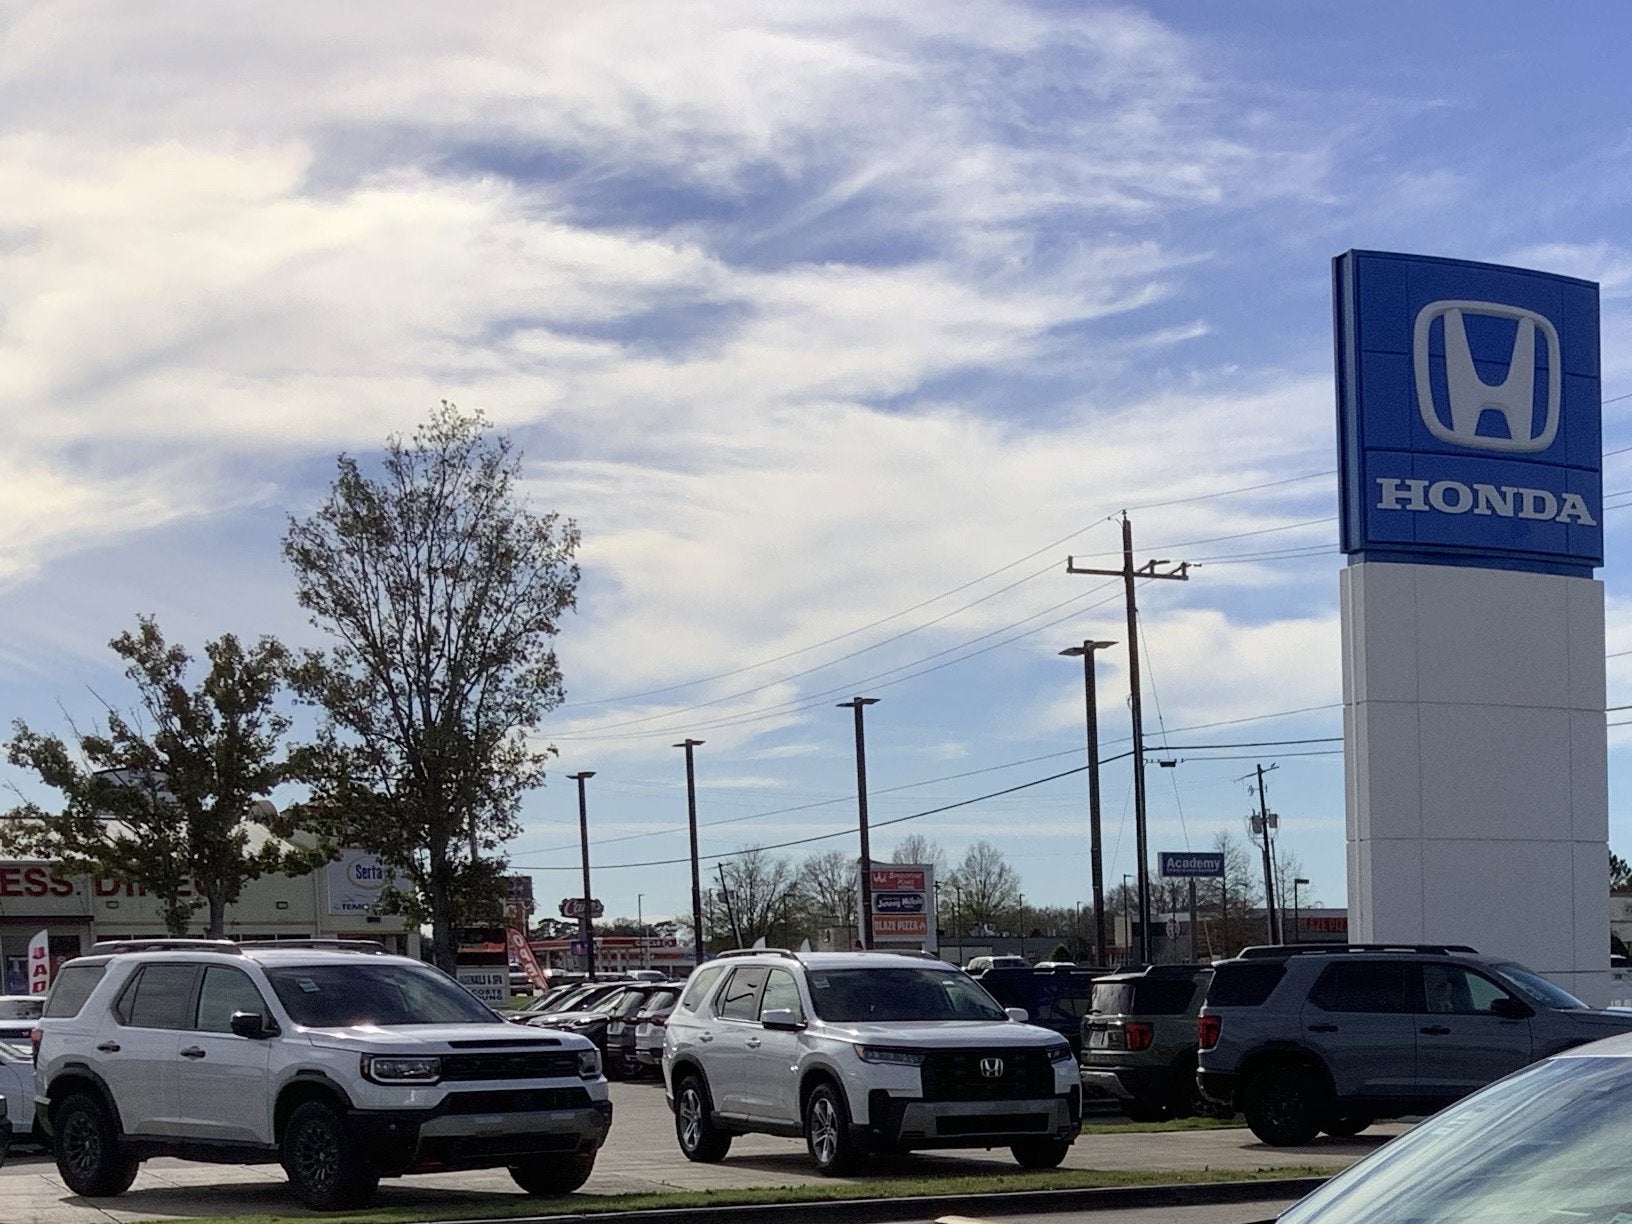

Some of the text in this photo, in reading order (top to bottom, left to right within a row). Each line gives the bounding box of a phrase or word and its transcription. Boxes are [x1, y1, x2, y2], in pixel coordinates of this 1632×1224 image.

[1375, 477, 1598, 527] HONDA
[1166, 857, 1221, 871] Academy
[355, 864, 383, 880] Serta
[874, 920, 919, 931] BLAZE PIZZA
